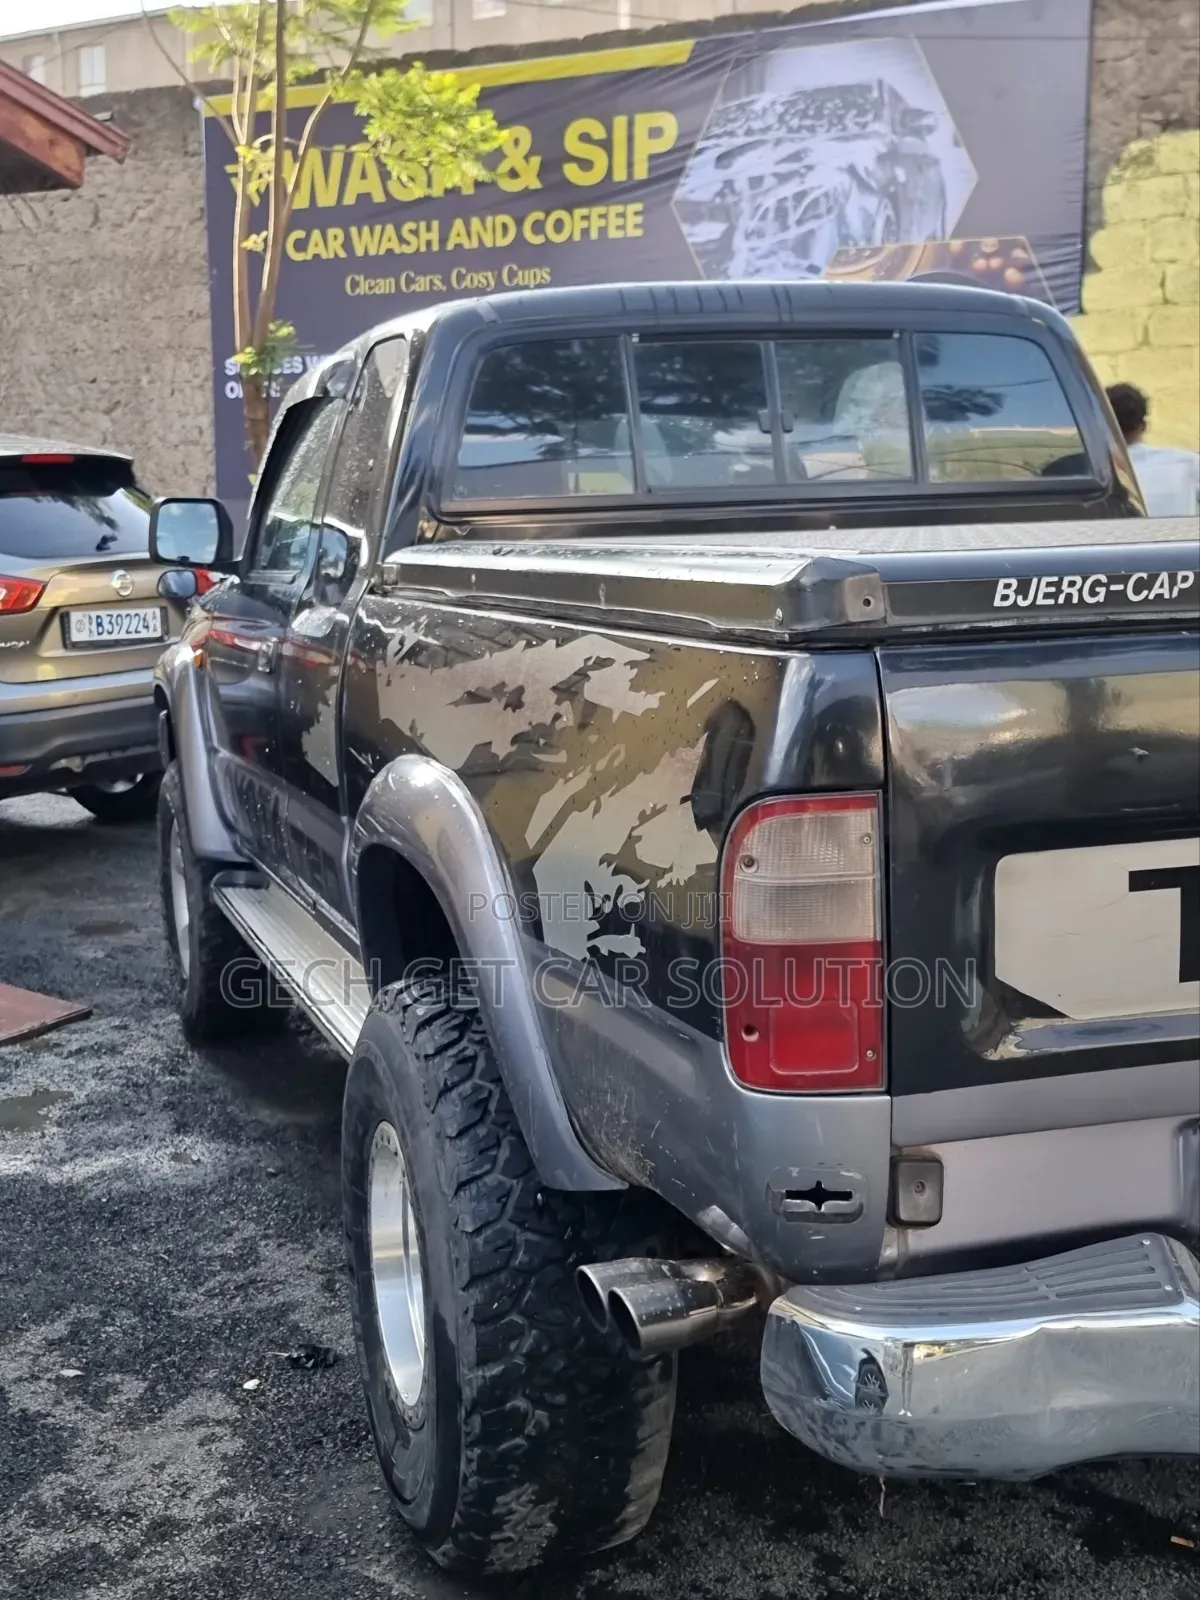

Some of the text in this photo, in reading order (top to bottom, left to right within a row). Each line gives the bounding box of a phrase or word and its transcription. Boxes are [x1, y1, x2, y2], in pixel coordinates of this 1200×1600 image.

[496, 124, 543, 193] &
[562, 111, 680, 187] SIP
[285, 202, 645, 262] CAR WASH AND COFFEE
[344, 273, 396, 297] Clean
[451, 267, 498, 291] Cosy
[502, 263, 551, 288] Cups
[993, 570, 1195, 608] BJERG-CAP
[95, 612, 150, 636] B39224
